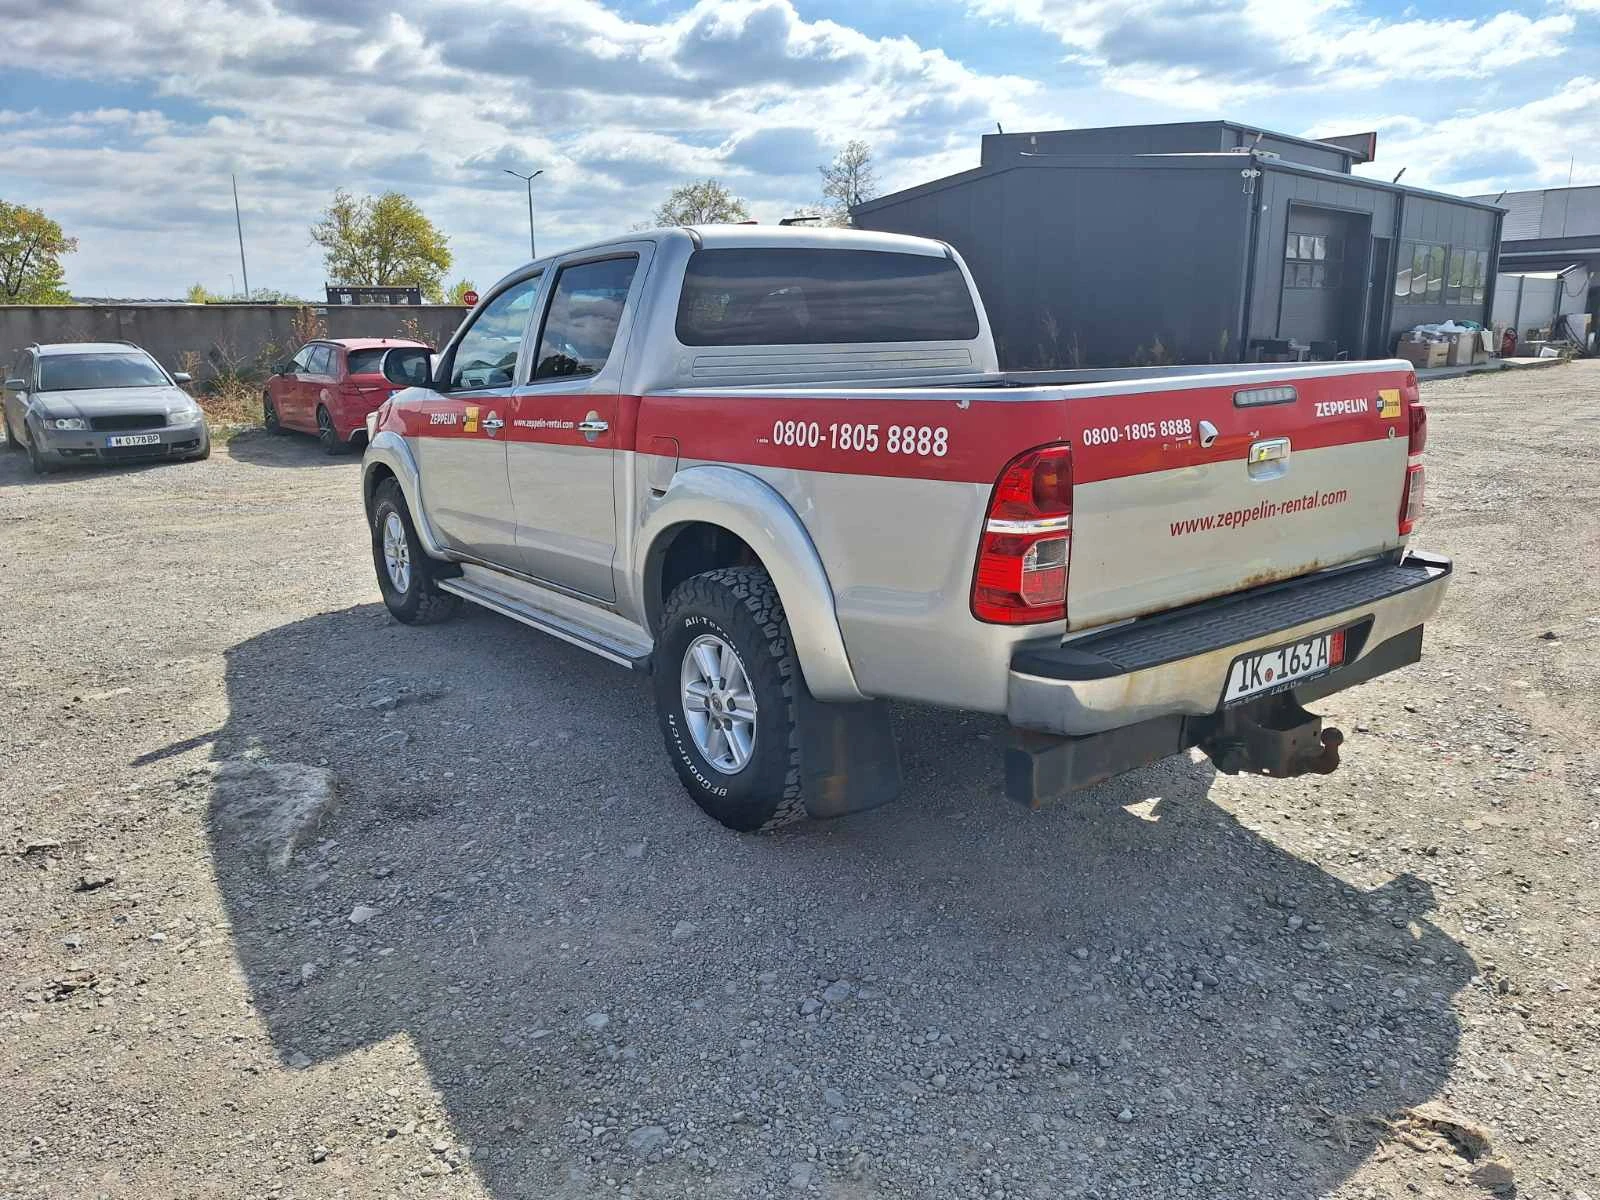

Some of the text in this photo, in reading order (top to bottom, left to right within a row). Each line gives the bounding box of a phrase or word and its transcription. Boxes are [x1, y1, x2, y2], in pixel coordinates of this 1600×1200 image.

[429, 412, 457, 425] ZEPPELIN
[1315, 398, 1369, 418] ZEPPELIN
[513, 418, 574, 430] www.zeppelin-rental.com
[1083, 418, 1192, 446] 0800-1805 8888
[773, 420, 949, 457] 0800-1805 8888
[1169, 488, 1348, 538] www.zeppelin-rental.com
